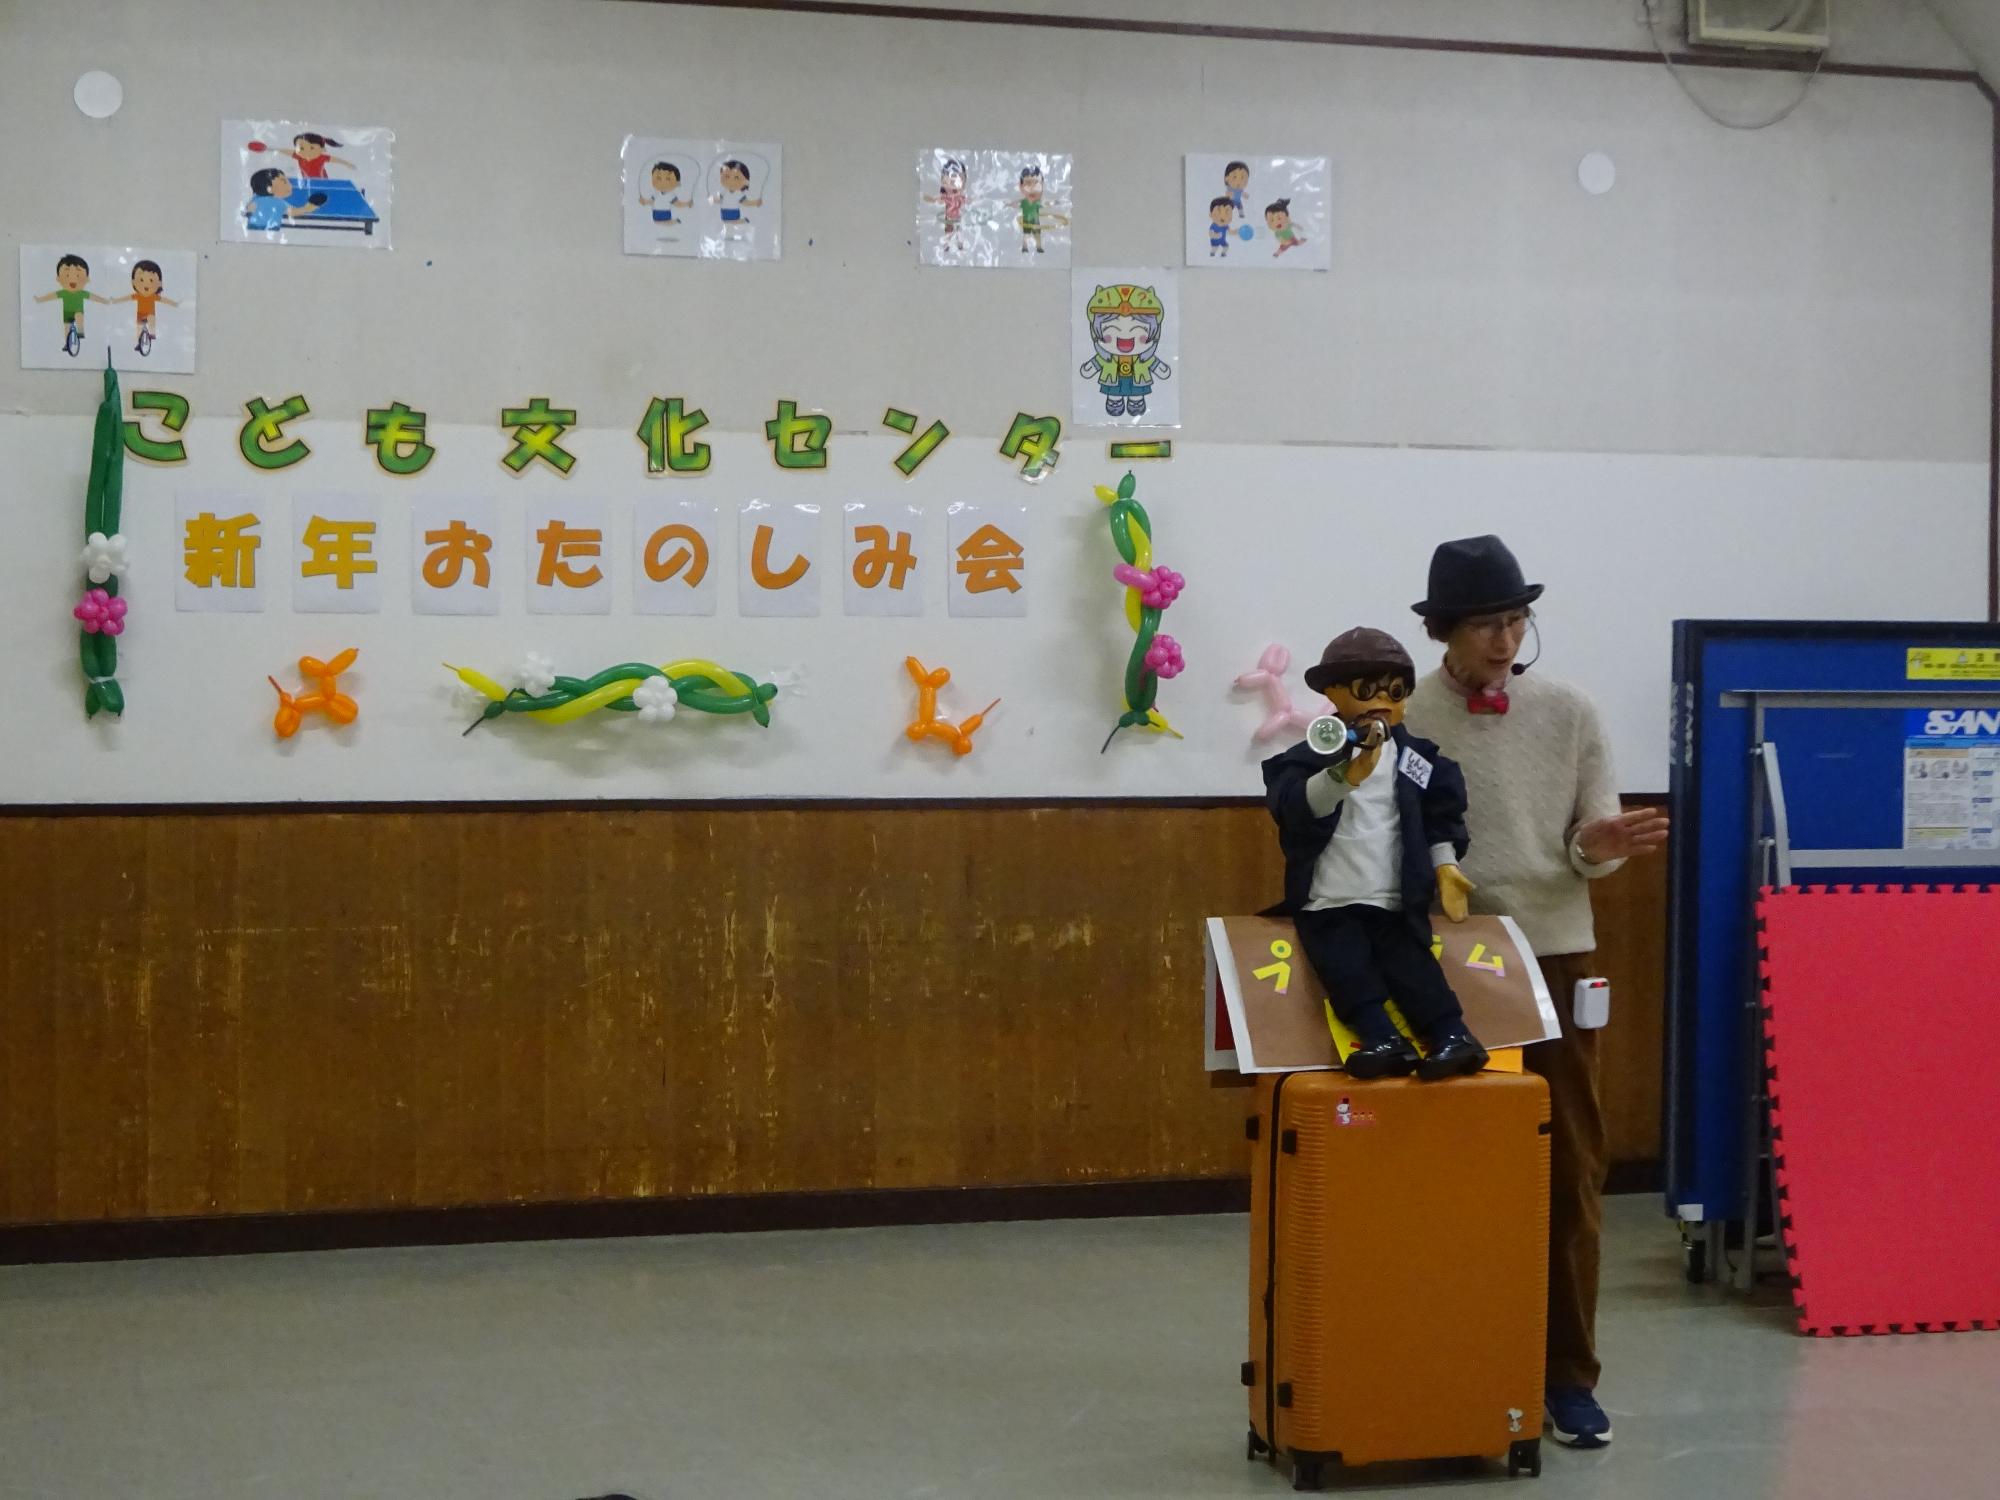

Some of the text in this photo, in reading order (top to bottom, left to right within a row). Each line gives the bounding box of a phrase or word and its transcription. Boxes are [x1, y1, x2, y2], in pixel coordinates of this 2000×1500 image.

[124, 390, 1172, 478] こども文化センター
[184, 512, 1024, 593] 新年おたのしみ会
